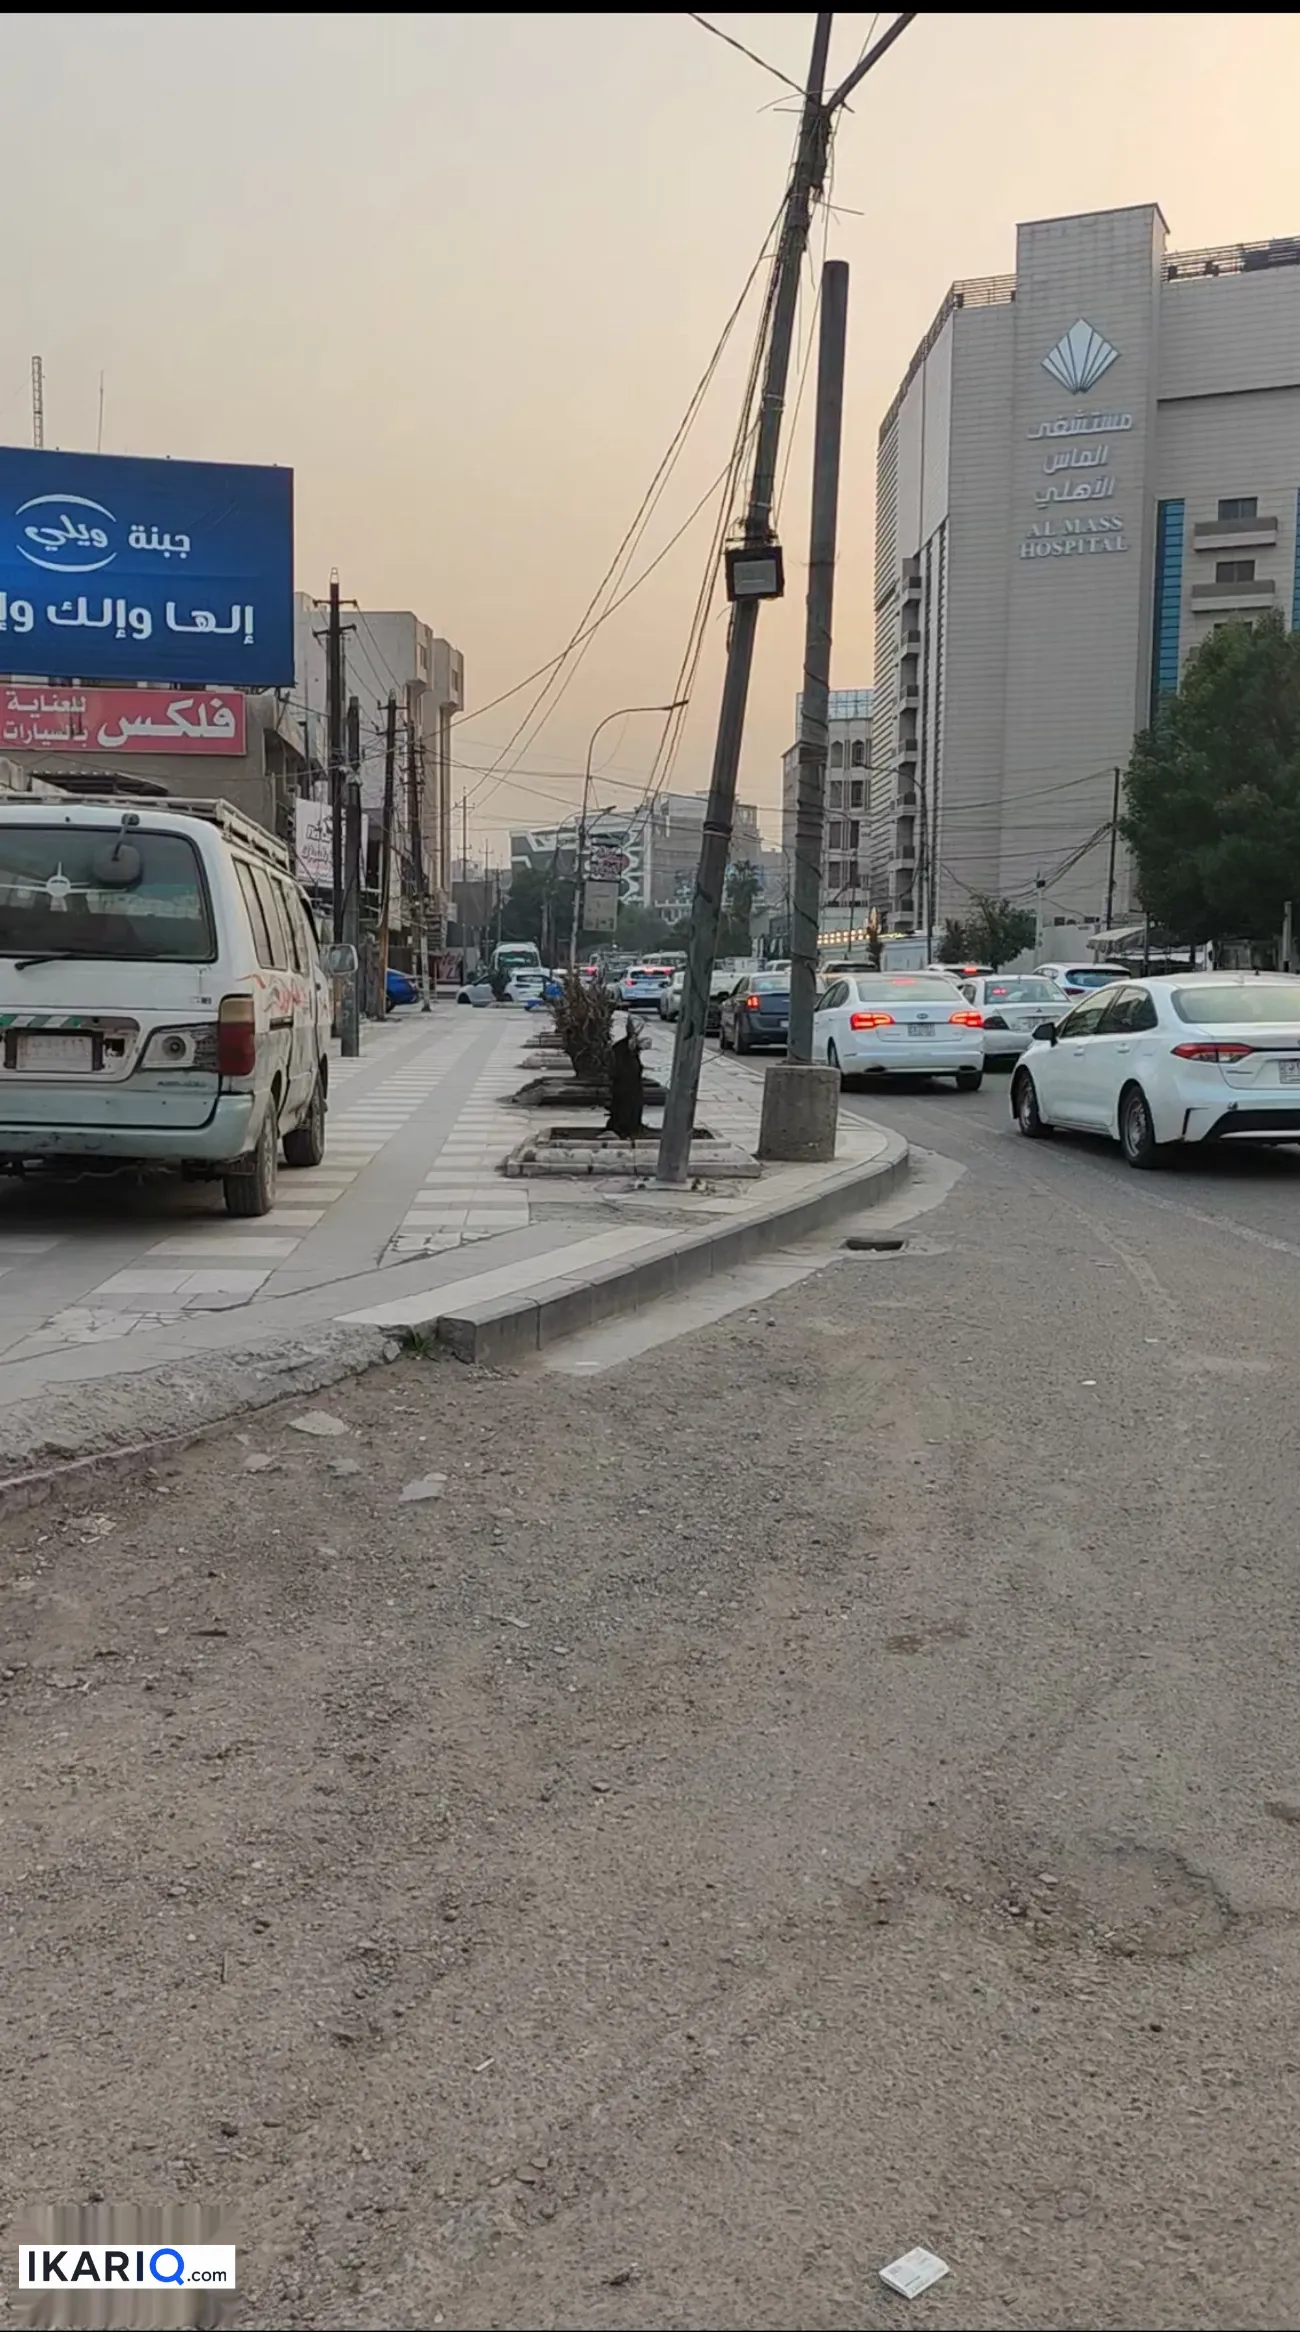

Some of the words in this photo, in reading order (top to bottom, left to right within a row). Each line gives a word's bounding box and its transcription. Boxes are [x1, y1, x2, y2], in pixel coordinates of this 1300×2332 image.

[1027, 409, 1133, 440] مستشفى
[1043, 444, 1109, 475] الماس
[24, 514, 109, 552] ويلي
[128, 524, 191, 559] جبنة
[1026, 520, 1056, 539] AL
[1062, 514, 1125, 536] MASS
[1020, 535, 1129, 559] HOSPITAL
[46, 596, 152, 639] وإلك
[166, 601, 254, 645] إلها
[6, 691, 87, 718] للعناية
[3, 720, 89, 748] بالسيارات
[97, 698, 236, 748] فلكس
